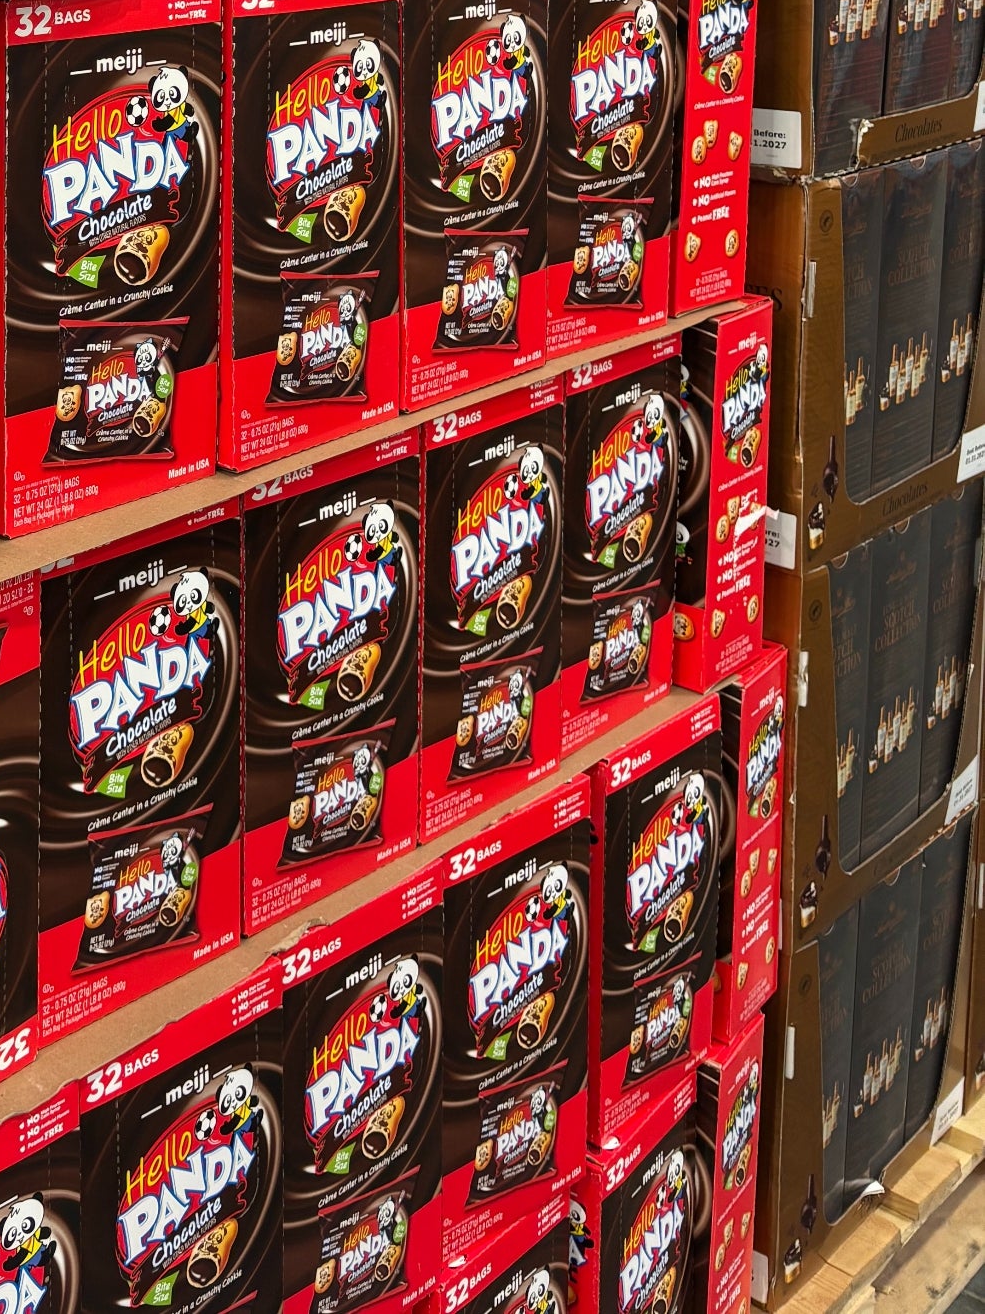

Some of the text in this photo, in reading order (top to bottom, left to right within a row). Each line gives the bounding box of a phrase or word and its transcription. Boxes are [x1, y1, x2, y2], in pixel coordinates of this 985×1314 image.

[14, 4, 91, 38] 32 BAGS
[96, 48, 143, 74] meiji
[571, 50, 657, 121] PANDA
[753, 129, 786, 139] Before:
[43, 130, 191, 229] PANDA
[78, 194, 153, 240] Chocolate
[447, 840, 503, 880] 32 BAGS
[281, 937, 342, 985] 32 BAGS
[305, 1015, 420, 1131] PANDA
